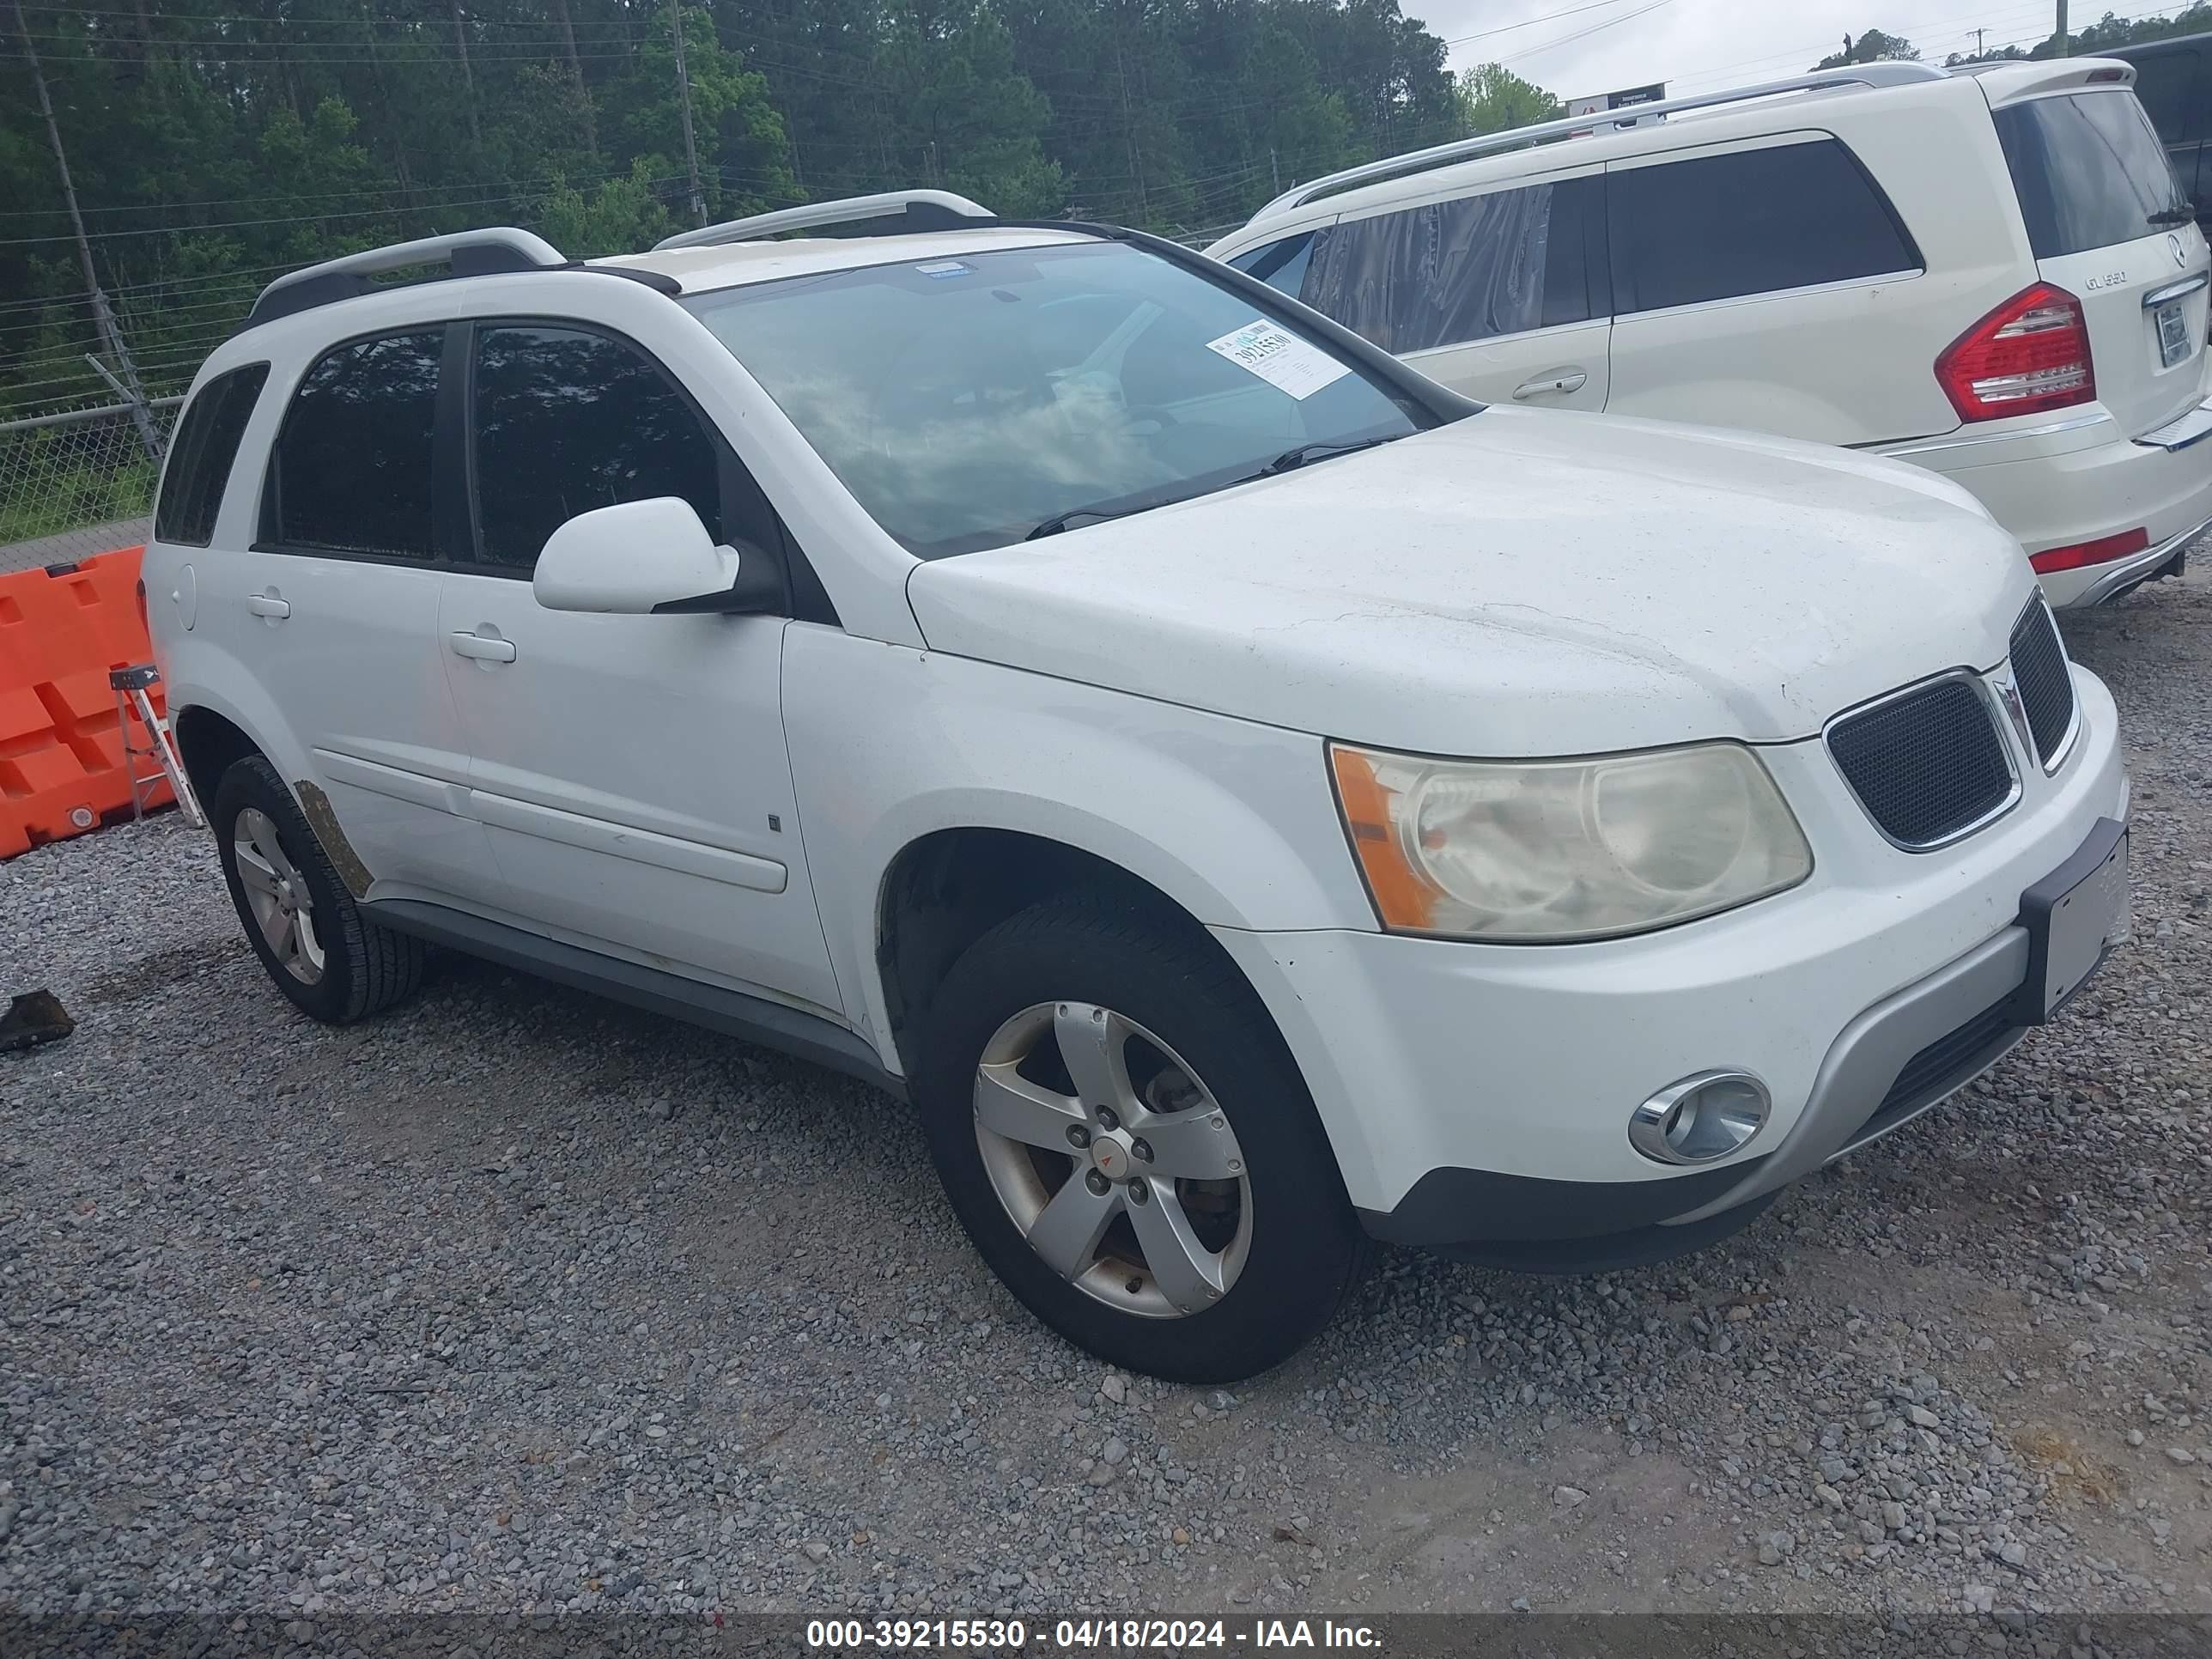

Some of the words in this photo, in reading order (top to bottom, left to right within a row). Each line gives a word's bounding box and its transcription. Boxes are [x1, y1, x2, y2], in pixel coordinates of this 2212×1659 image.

[2086, 276, 2103, 290] GL
[2103, 270, 2128, 286] 550
[1235, 333, 1292, 364] 39215530
